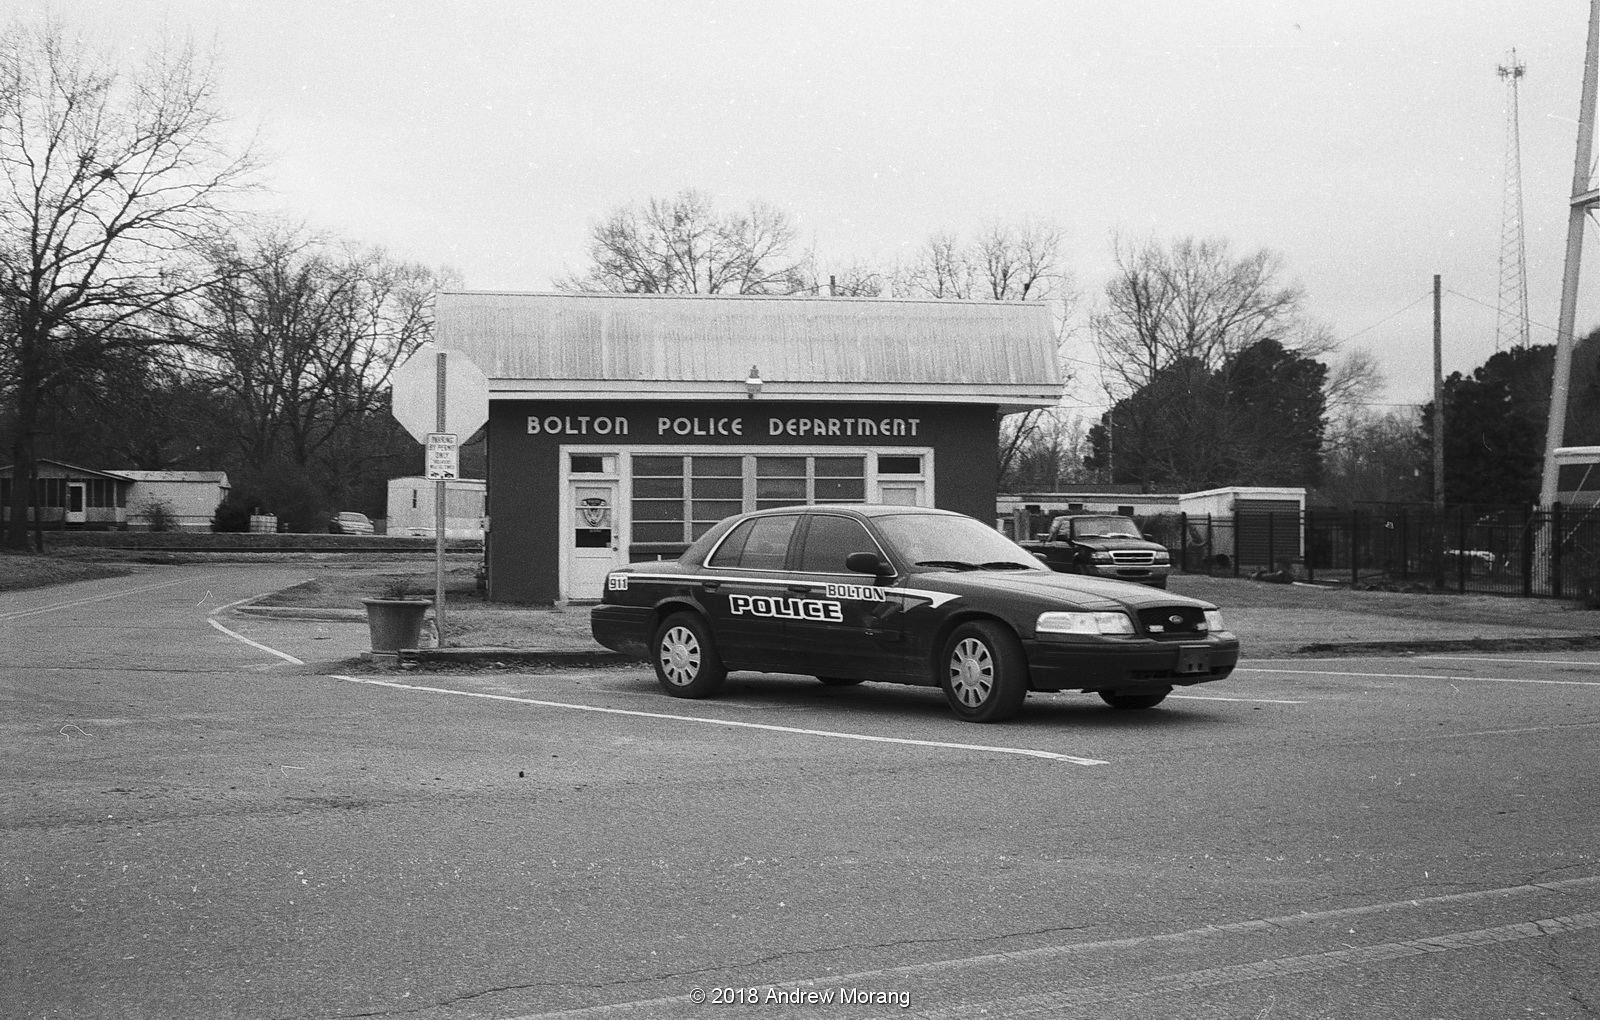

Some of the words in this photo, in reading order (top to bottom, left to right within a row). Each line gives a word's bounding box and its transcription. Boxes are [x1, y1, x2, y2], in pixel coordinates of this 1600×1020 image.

[527, 416, 629, 435] BOLTON
[658, 417, 742, 435] POLICE
[769, 418, 920, 436] DEPARTMENT
[608, 577, 628, 590] 911
[826, 584, 885, 601] BOLTON
[729, 594, 843, 622] POLICE
